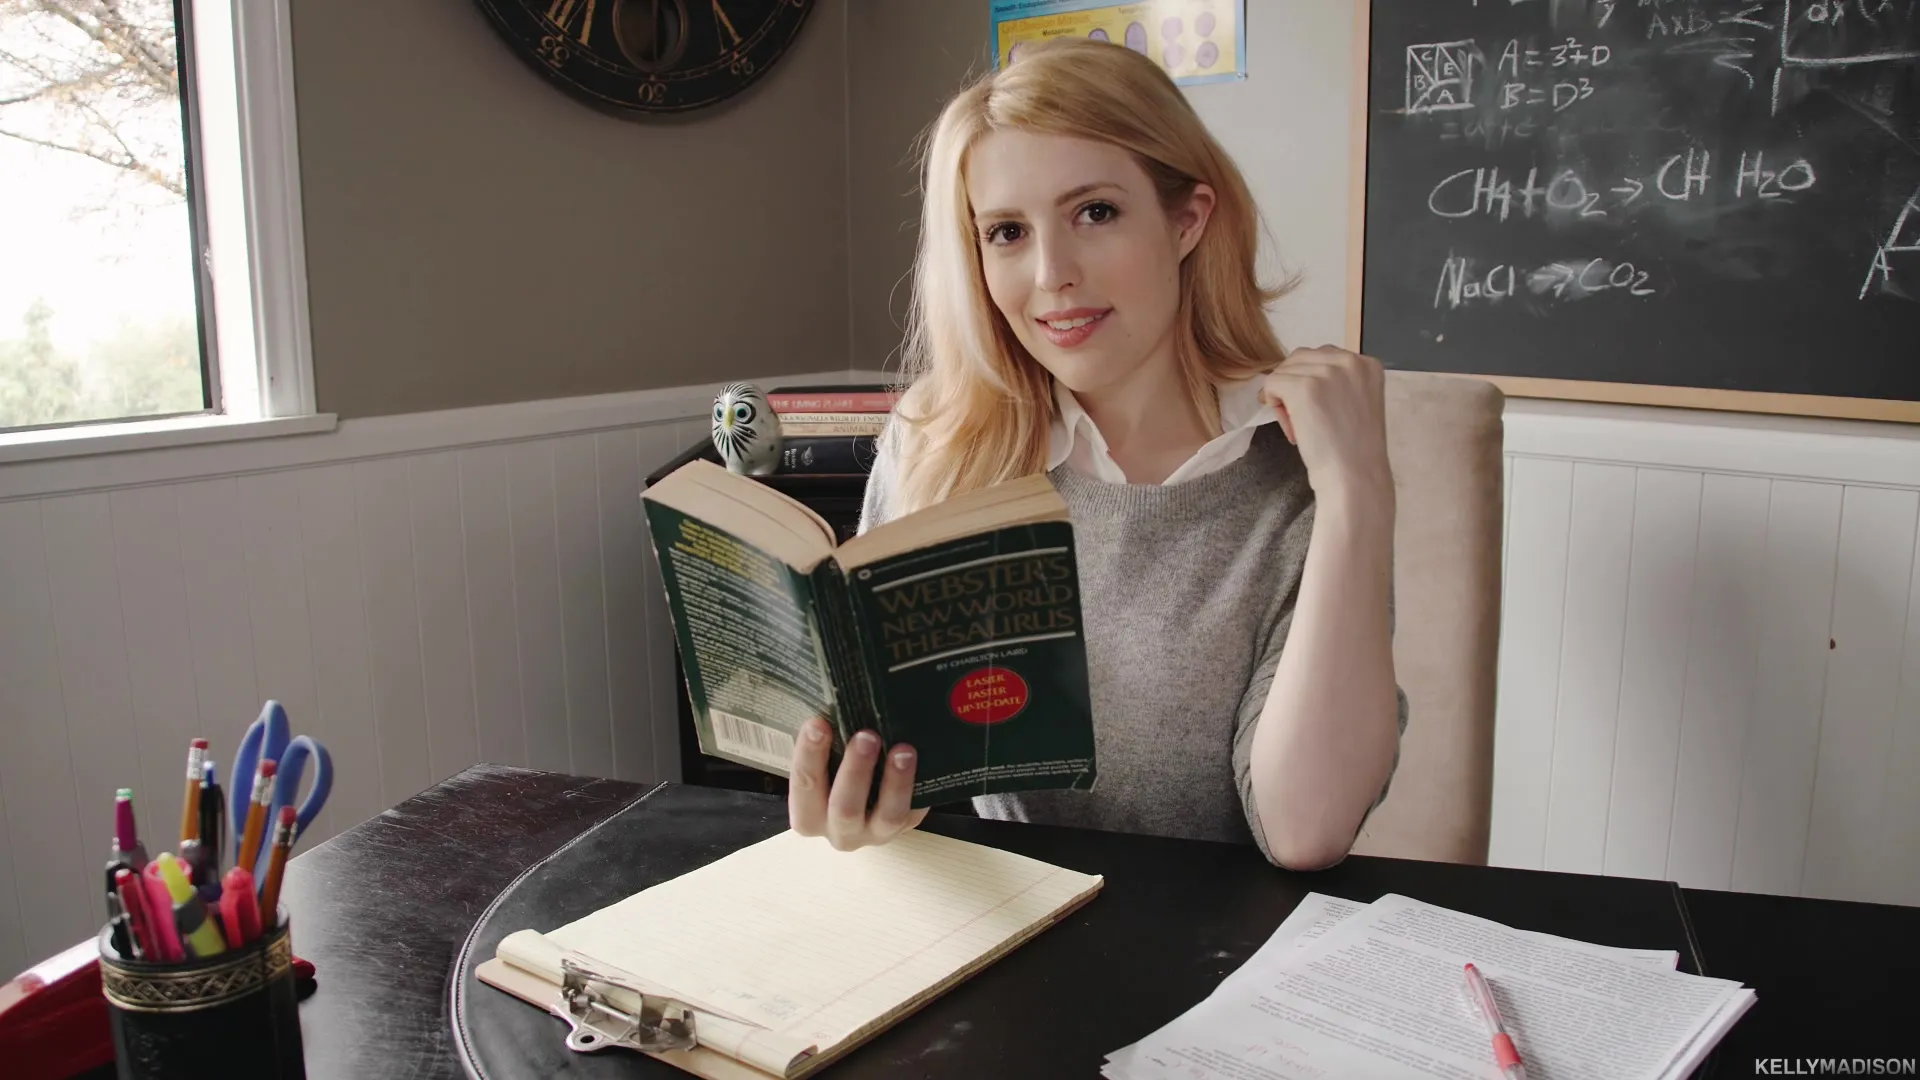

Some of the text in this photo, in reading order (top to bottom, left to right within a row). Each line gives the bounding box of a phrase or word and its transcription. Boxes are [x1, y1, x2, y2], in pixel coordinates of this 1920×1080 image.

[1657, 148, 1711, 200] CH
[877, 556, 1070, 614] WEBSTER'S
[881, 584, 1073, 640] NEW WORLD
[886, 607, 1076, 662] THESAURUS
[968, 687, 1007, 700] FASTER
